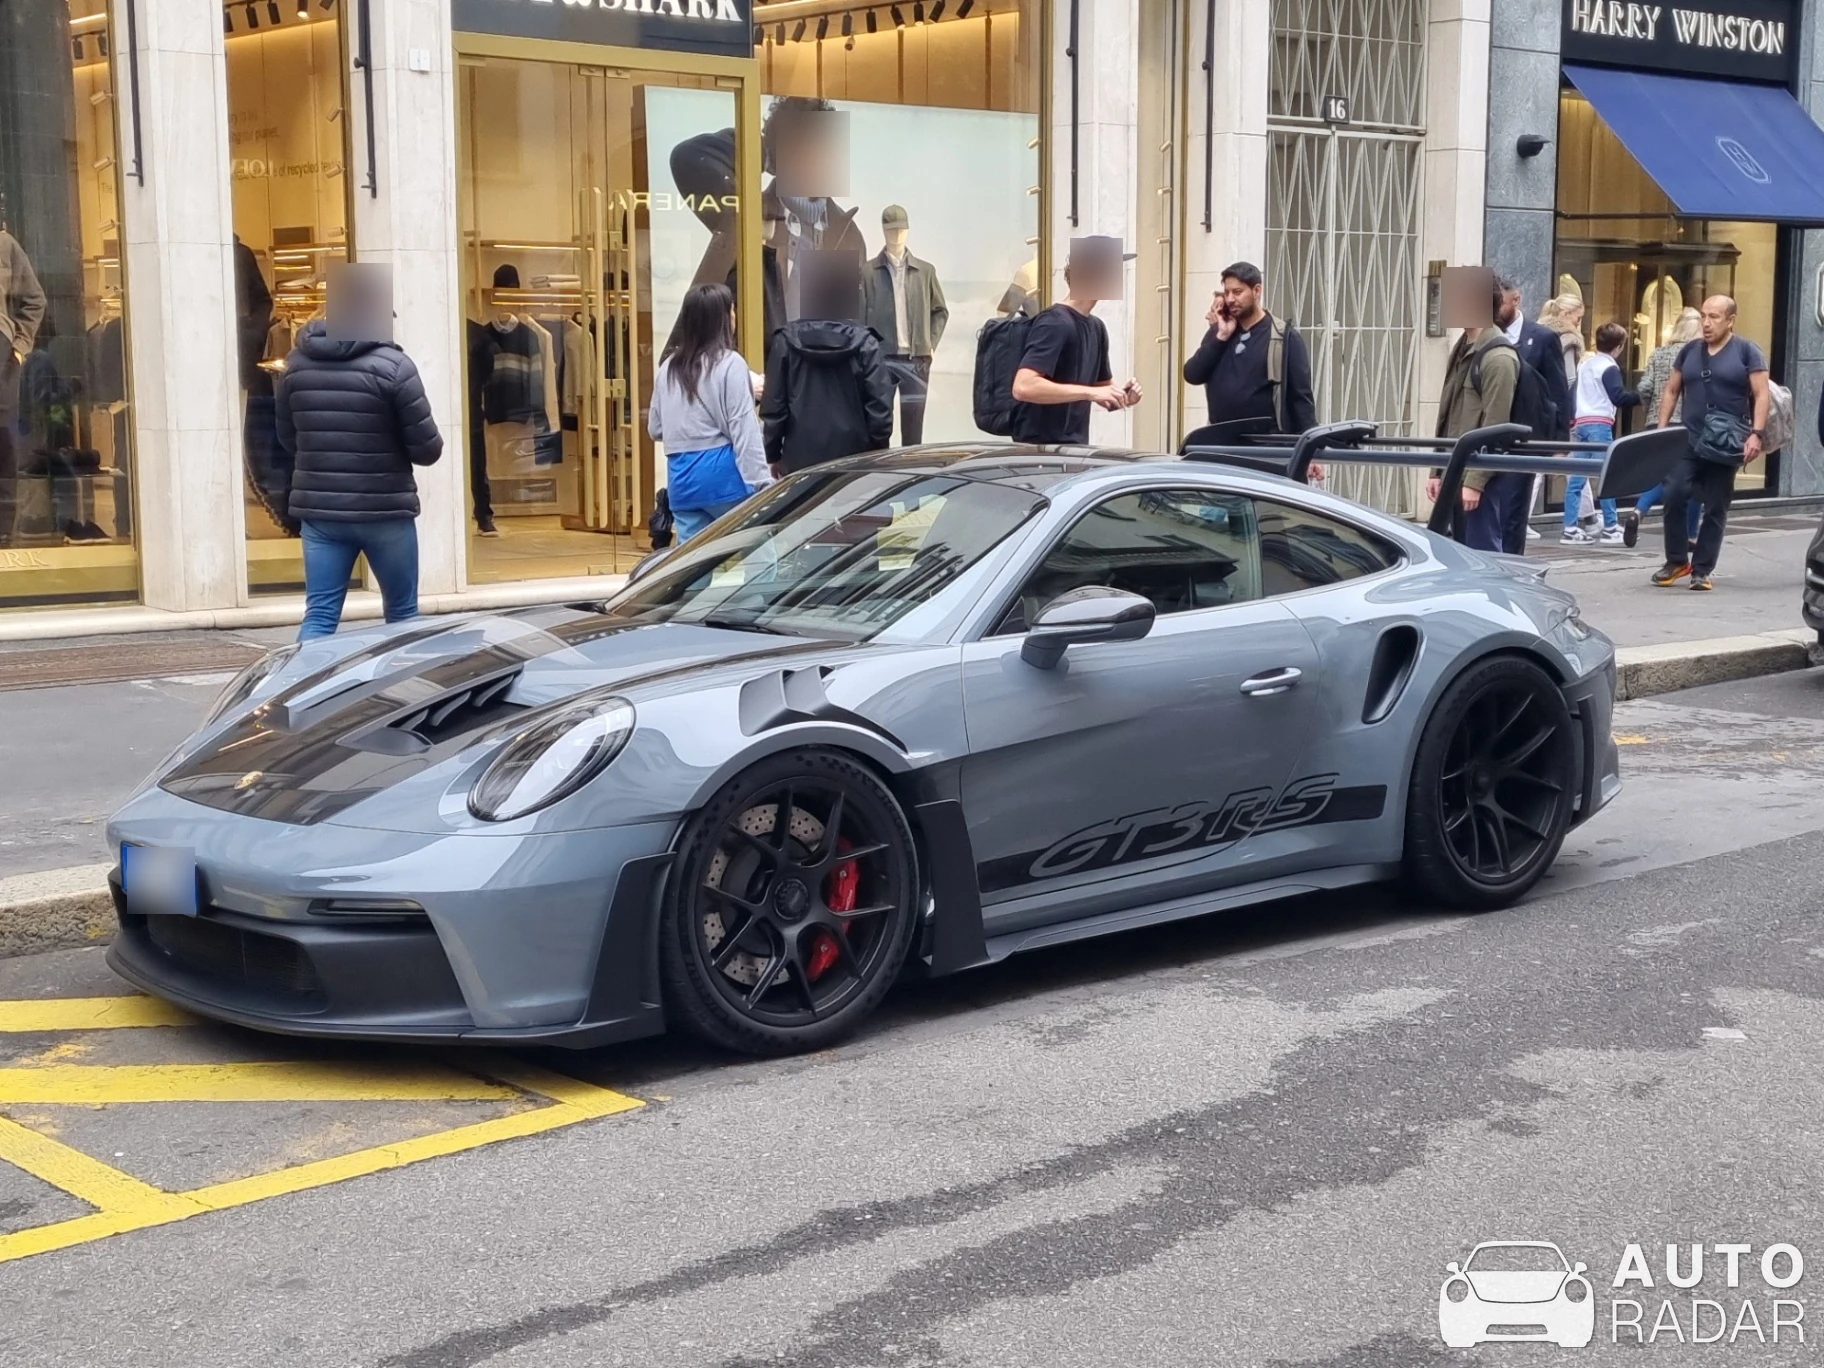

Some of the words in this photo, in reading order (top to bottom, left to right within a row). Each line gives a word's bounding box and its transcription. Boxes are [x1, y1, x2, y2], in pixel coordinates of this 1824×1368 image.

[1572, 0, 1662, 40] HARRY
[1672, 8, 1785, 54] WINSTON
[1329, 98, 1346, 120] 16
[0, 551, 49, 568] RK
